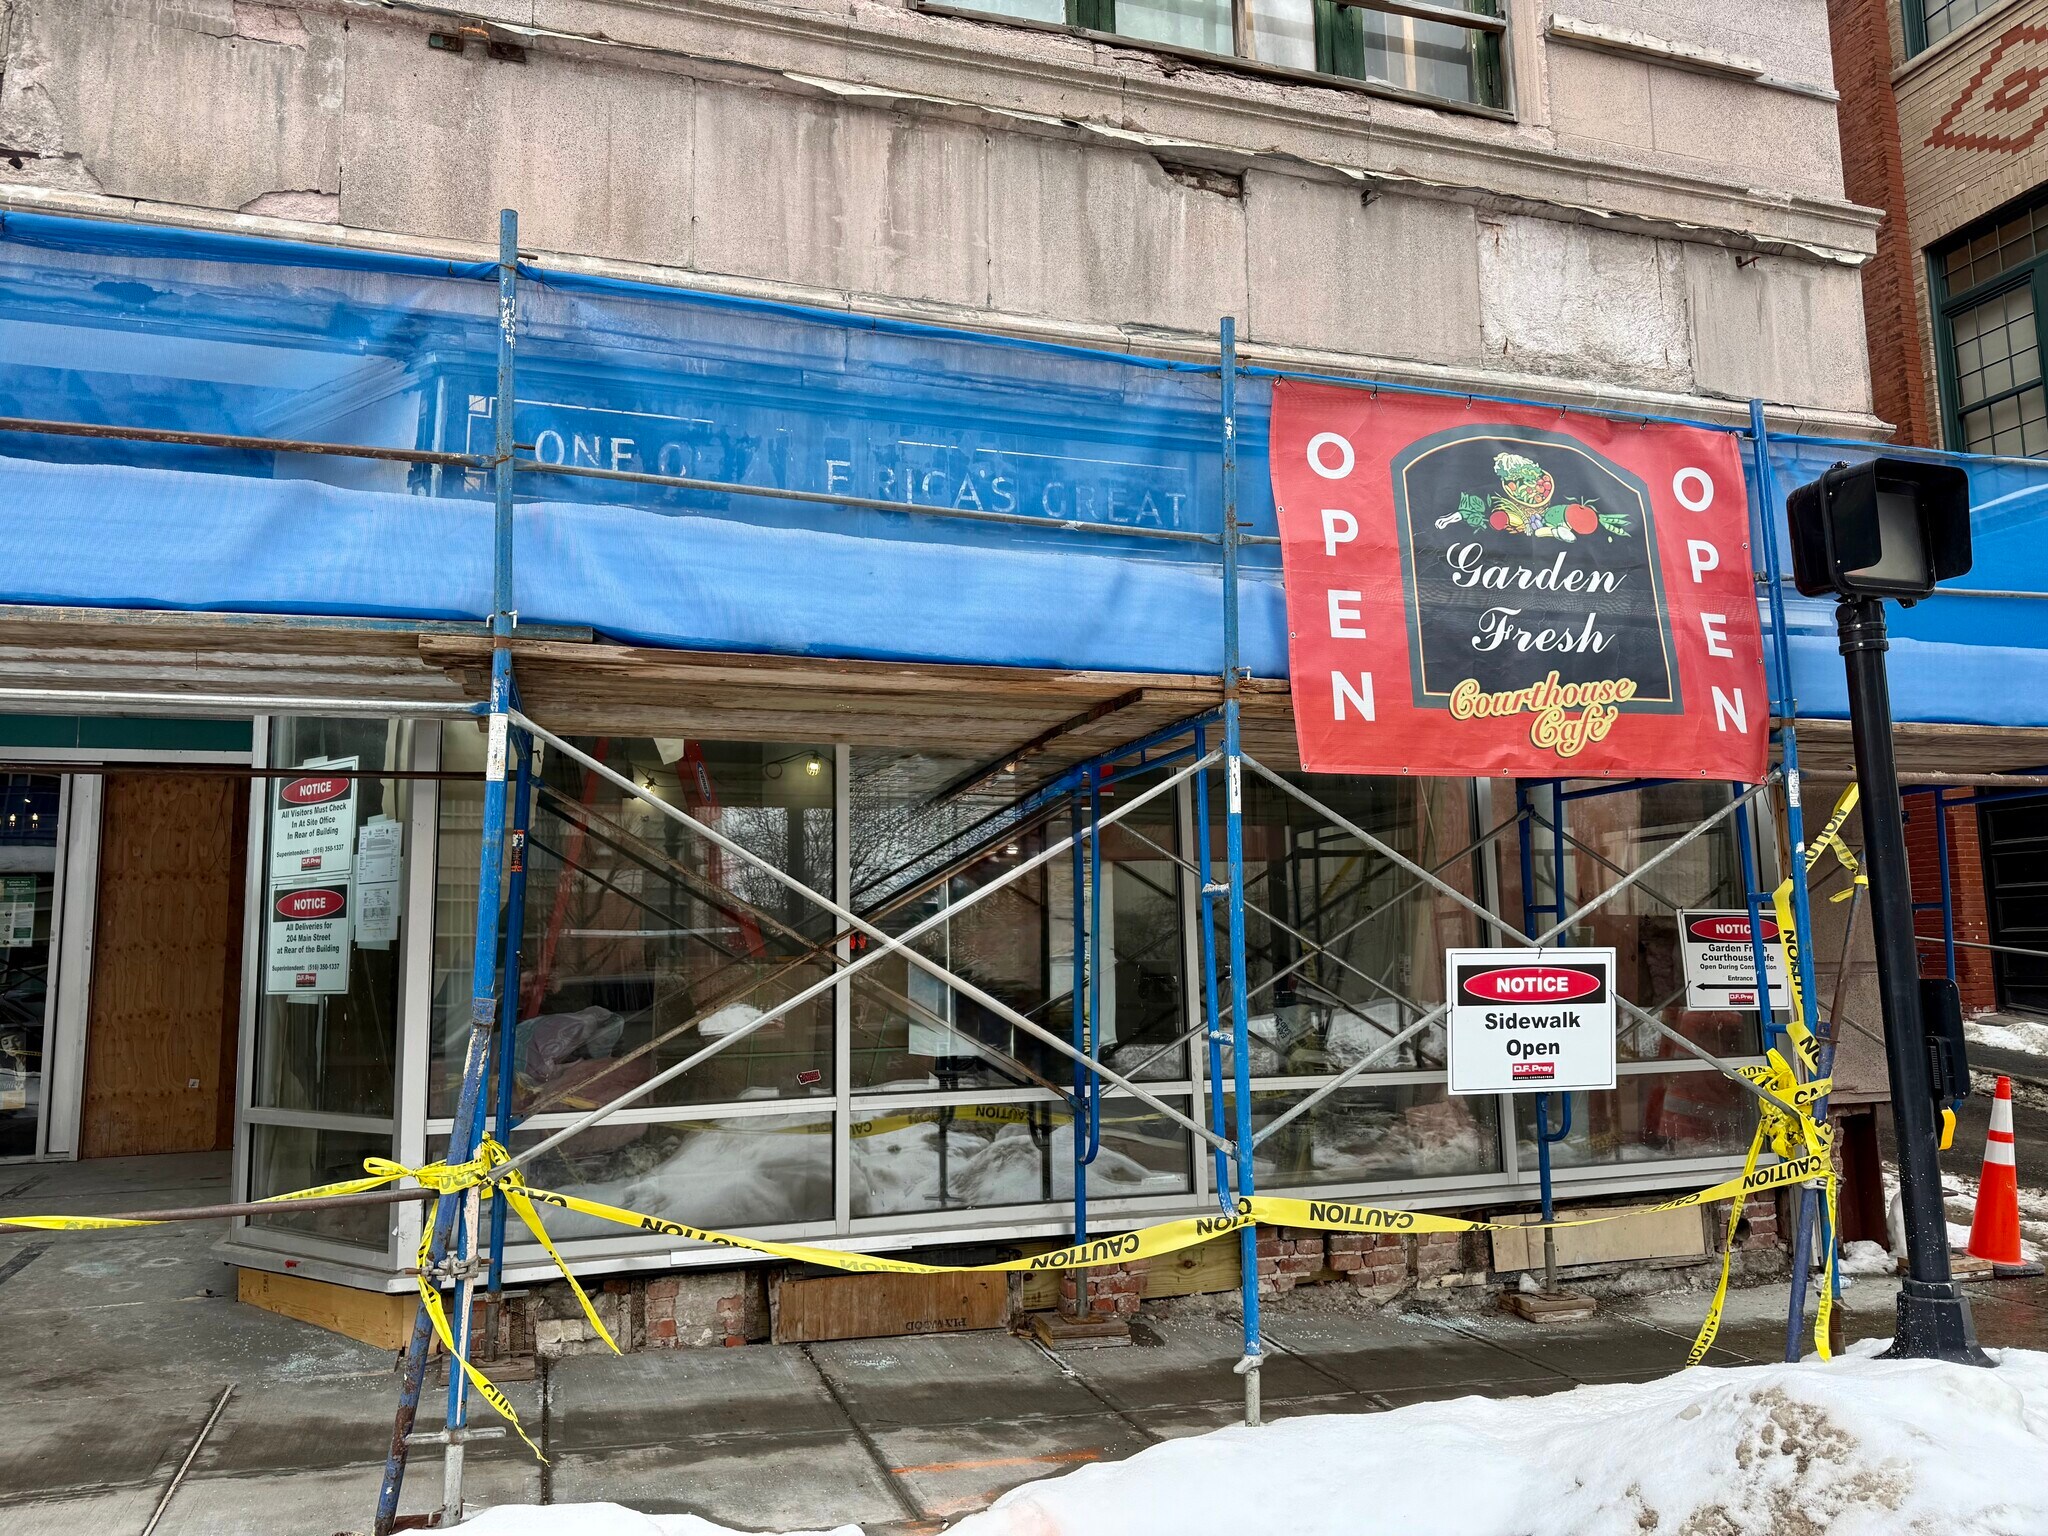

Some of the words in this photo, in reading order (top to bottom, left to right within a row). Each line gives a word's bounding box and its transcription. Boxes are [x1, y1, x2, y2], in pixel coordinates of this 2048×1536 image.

[535, 430, 635, 473] ONE
[1042, 481, 1187, 527] GREAT
[1306, 431, 1376, 722] OPEN
[1446, 542, 1627, 594] Garden
[1672, 466, 1748, 734] OPEN
[1471, 606, 1616, 654] Fresh
[1450, 670, 1637, 721] Courthouse
[300, 781, 332, 797] NOTICE
[281, 811, 290, 819] All
[291, 807, 313, 818] Visitors
[314, 805, 328, 815] Must
[329, 802, 347, 813] Check
[298, 819, 306, 828] At
[307, 818, 318, 827] Site
[319, 816, 336, 825] Office
[287, 832, 294, 840] In
[294, 830, 307, 839] Rear
[308, 830, 315, 838] of
[316, 827, 339, 837] Building
[294, 897, 326, 911] NOTICE
[286, 924, 294, 932] All
[295, 922, 323, 931] Deliveries
[324, 921, 333, 930] for
[1715, 924, 1751, 934] NOTIC
[286, 935, 297, 943] 204
[298, 934, 312, 942] Main
[312, 933, 331, 941] Street
[284, 946, 297, 954] Rear
[305, 945, 315, 953] the
[316, 944, 340, 955] Building
[1708, 944, 1742, 952] Garden
[1701, 953, 1753, 962] Courthouse
[1718, 963, 1738, 971] During
[1740, 963, 1777, 971] Constion
[1496, 976, 1569, 993] NOTICE
[1484, 1011, 1581, 1030] Sidewalk
[1506, 1039, 1560, 1060] Open
[1741, 1154, 1822, 1190] CAUTION
[1308, 1202, 1415, 1230] CAUTION
[1030, 1232, 1140, 1270] CAUTION
